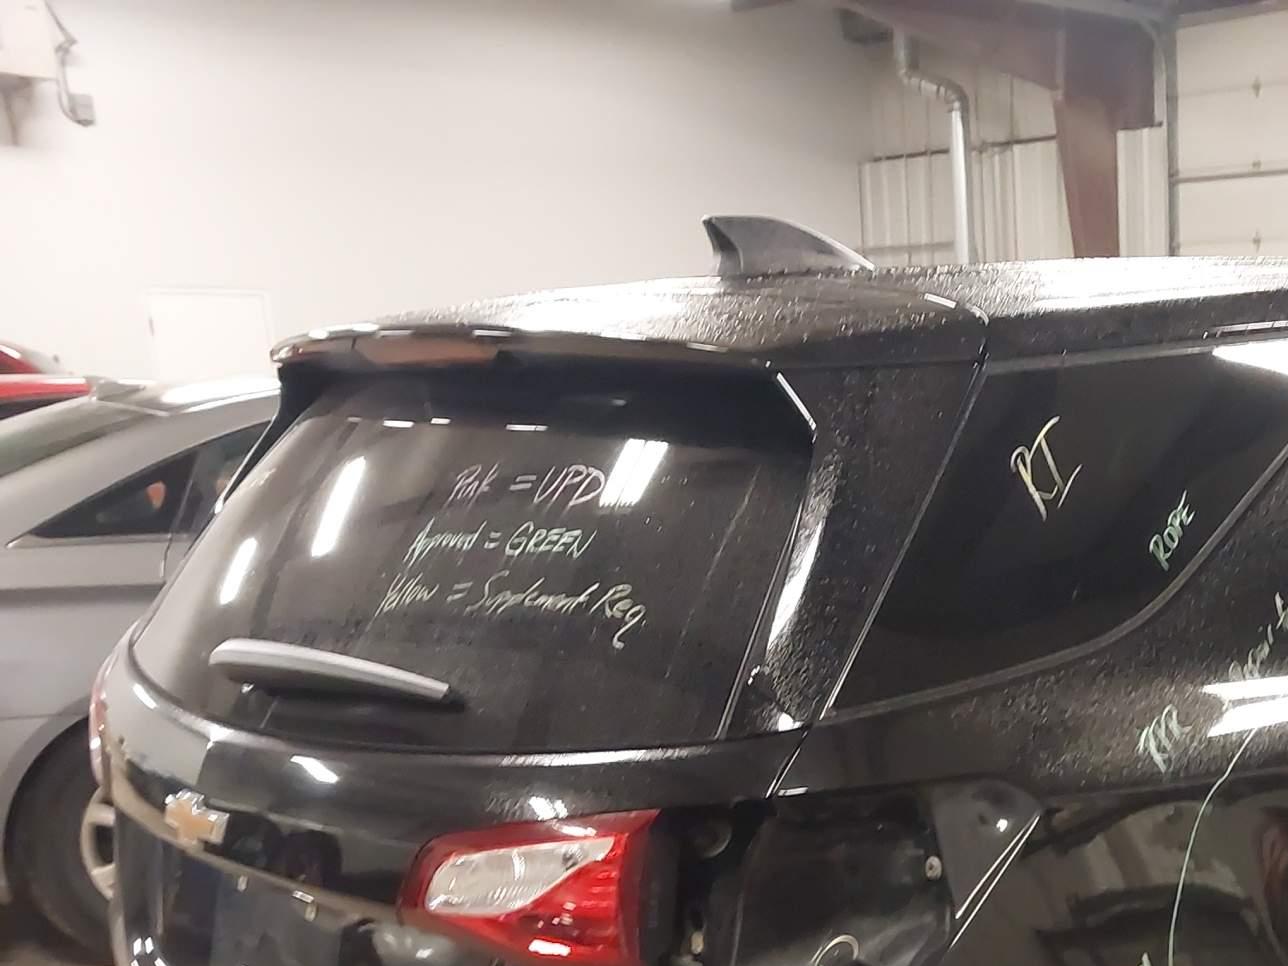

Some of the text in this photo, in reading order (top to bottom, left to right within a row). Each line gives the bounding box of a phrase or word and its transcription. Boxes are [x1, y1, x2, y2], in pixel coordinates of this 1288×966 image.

[447, 462, 500, 506] Pink
[533, 464, 606, 507] UPD
[403, 517, 487, 567] Approved
[504, 520, 598, 559] GREEN
[374, 572, 439, 617] Yellow
[464, 570, 600, 616] Supplement
